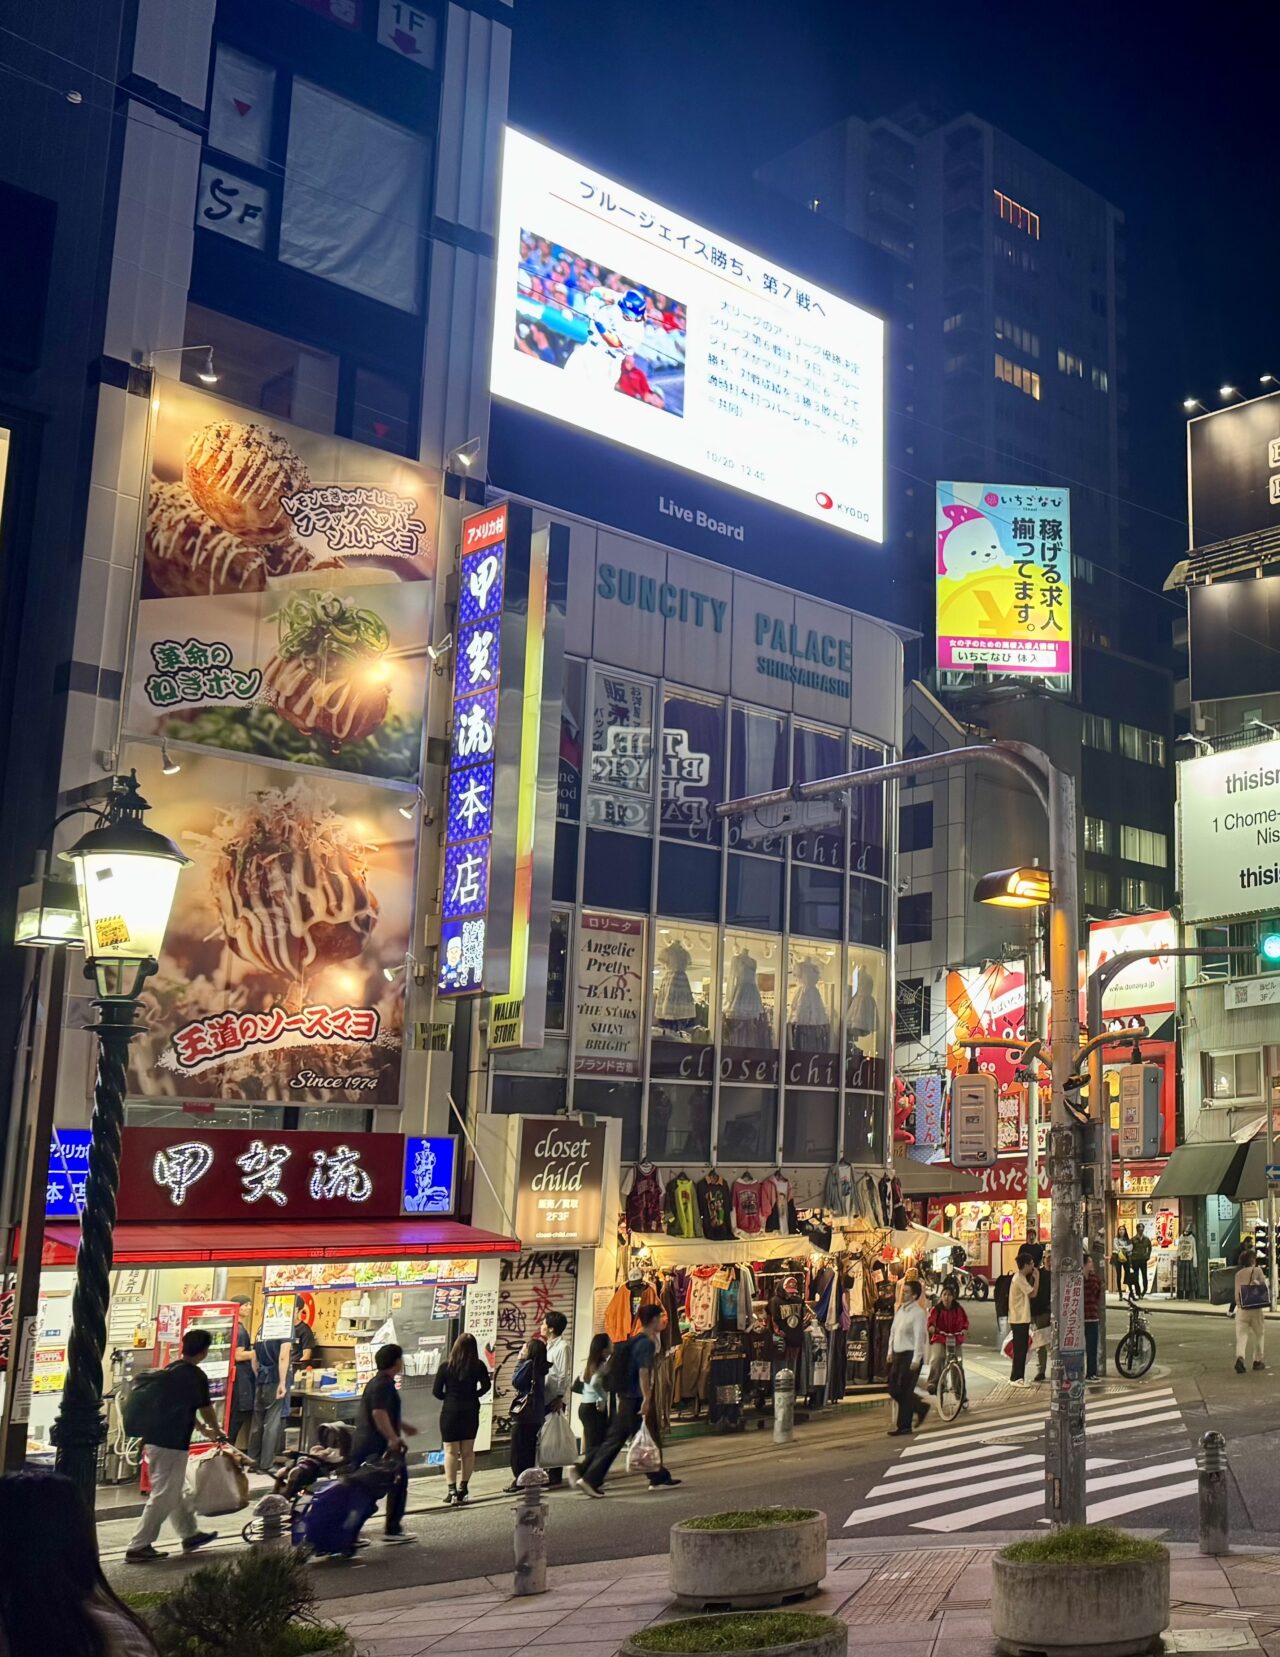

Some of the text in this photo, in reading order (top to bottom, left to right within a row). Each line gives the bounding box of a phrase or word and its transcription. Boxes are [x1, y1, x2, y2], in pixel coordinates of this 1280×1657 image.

[837, 502, 870, 523] KYODO
[1001, 494, 1063, 508] いちごなび
[466, 514, 505, 543] アメリカ村
[658, 496, 745, 542] Live Board
[1012, 517, 1036, 632] 揃ってます。
[1039, 518, 1064, 632] 稼げる求人
[598, 563, 728, 634] SUNCITY
[755, 612, 853, 672] PALACE
[958, 651, 1011, 662] いちごなび
[152, 643, 233, 673] 革命の
[149, 672, 260, 704] ねぎポン
[756, 655, 851, 699] SHINSAIBASHI
[450, 555, 500, 904] 甲賀流本店
[1212, 817, 1219, 834] 1
[589, 918, 632, 932] ロリータ
[581, 938, 636, 958] Angelic
[586, 957, 631, 976] Pretty
[577, 1002, 638, 1020] THE STARS
[174, 1007, 379, 1065] 王道のソースマヨ
[493, 1022, 518, 1044] STORE
[585, 1038, 631, 1053] BRIGHT
[575, 1058, 634, 1074] ブランド古着
[679, 1046, 780, 1081] closet
[290, 1071, 378, 1091] Since 1974
[534, 1128, 592, 1159] closet
[153, 1139, 373, 1208] 甲賀流
[531, 1161, 590, 1192] child
[469, 1318, 494, 1328] 2F 3F
